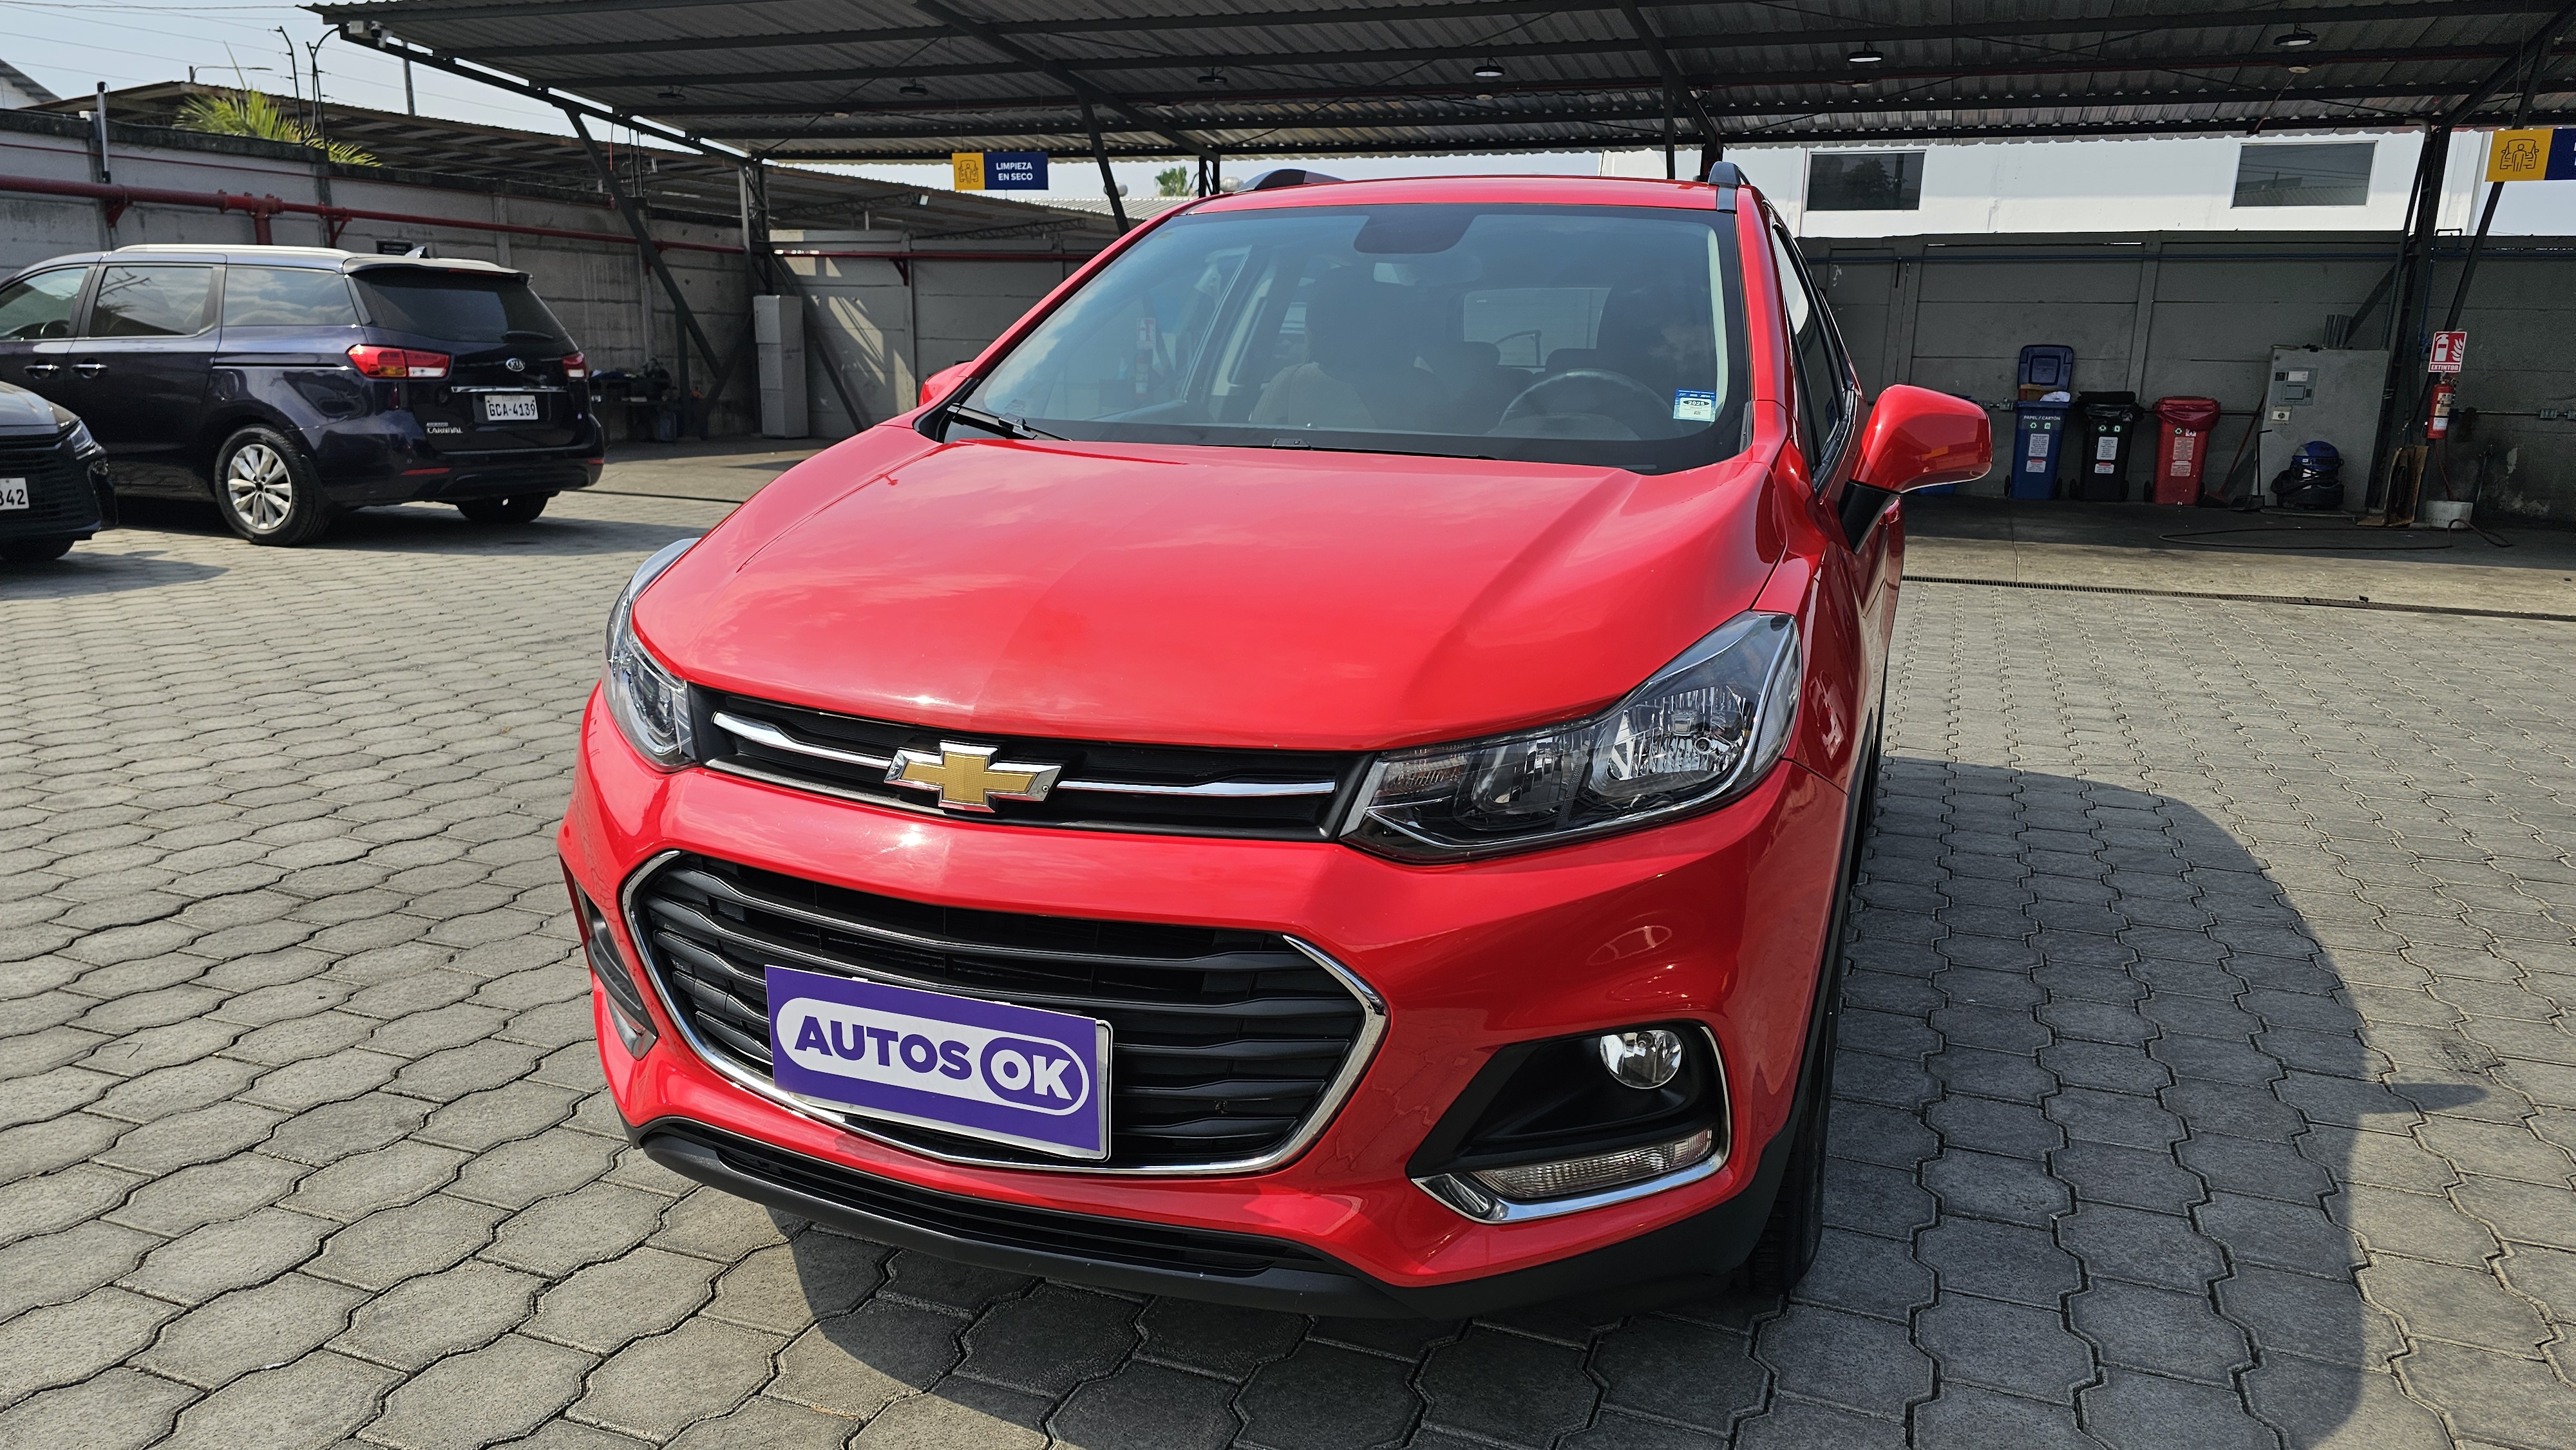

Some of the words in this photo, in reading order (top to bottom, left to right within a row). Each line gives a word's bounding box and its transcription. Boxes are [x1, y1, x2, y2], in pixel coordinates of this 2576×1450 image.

[998, 173, 1010, 181] EN
[1010, 173, 1033, 181] SECO
[489, 403, 536, 417] GCA-4139
[794, 1015, 972, 1080] AUTOS
[990, 1048, 1072, 1100] OK
